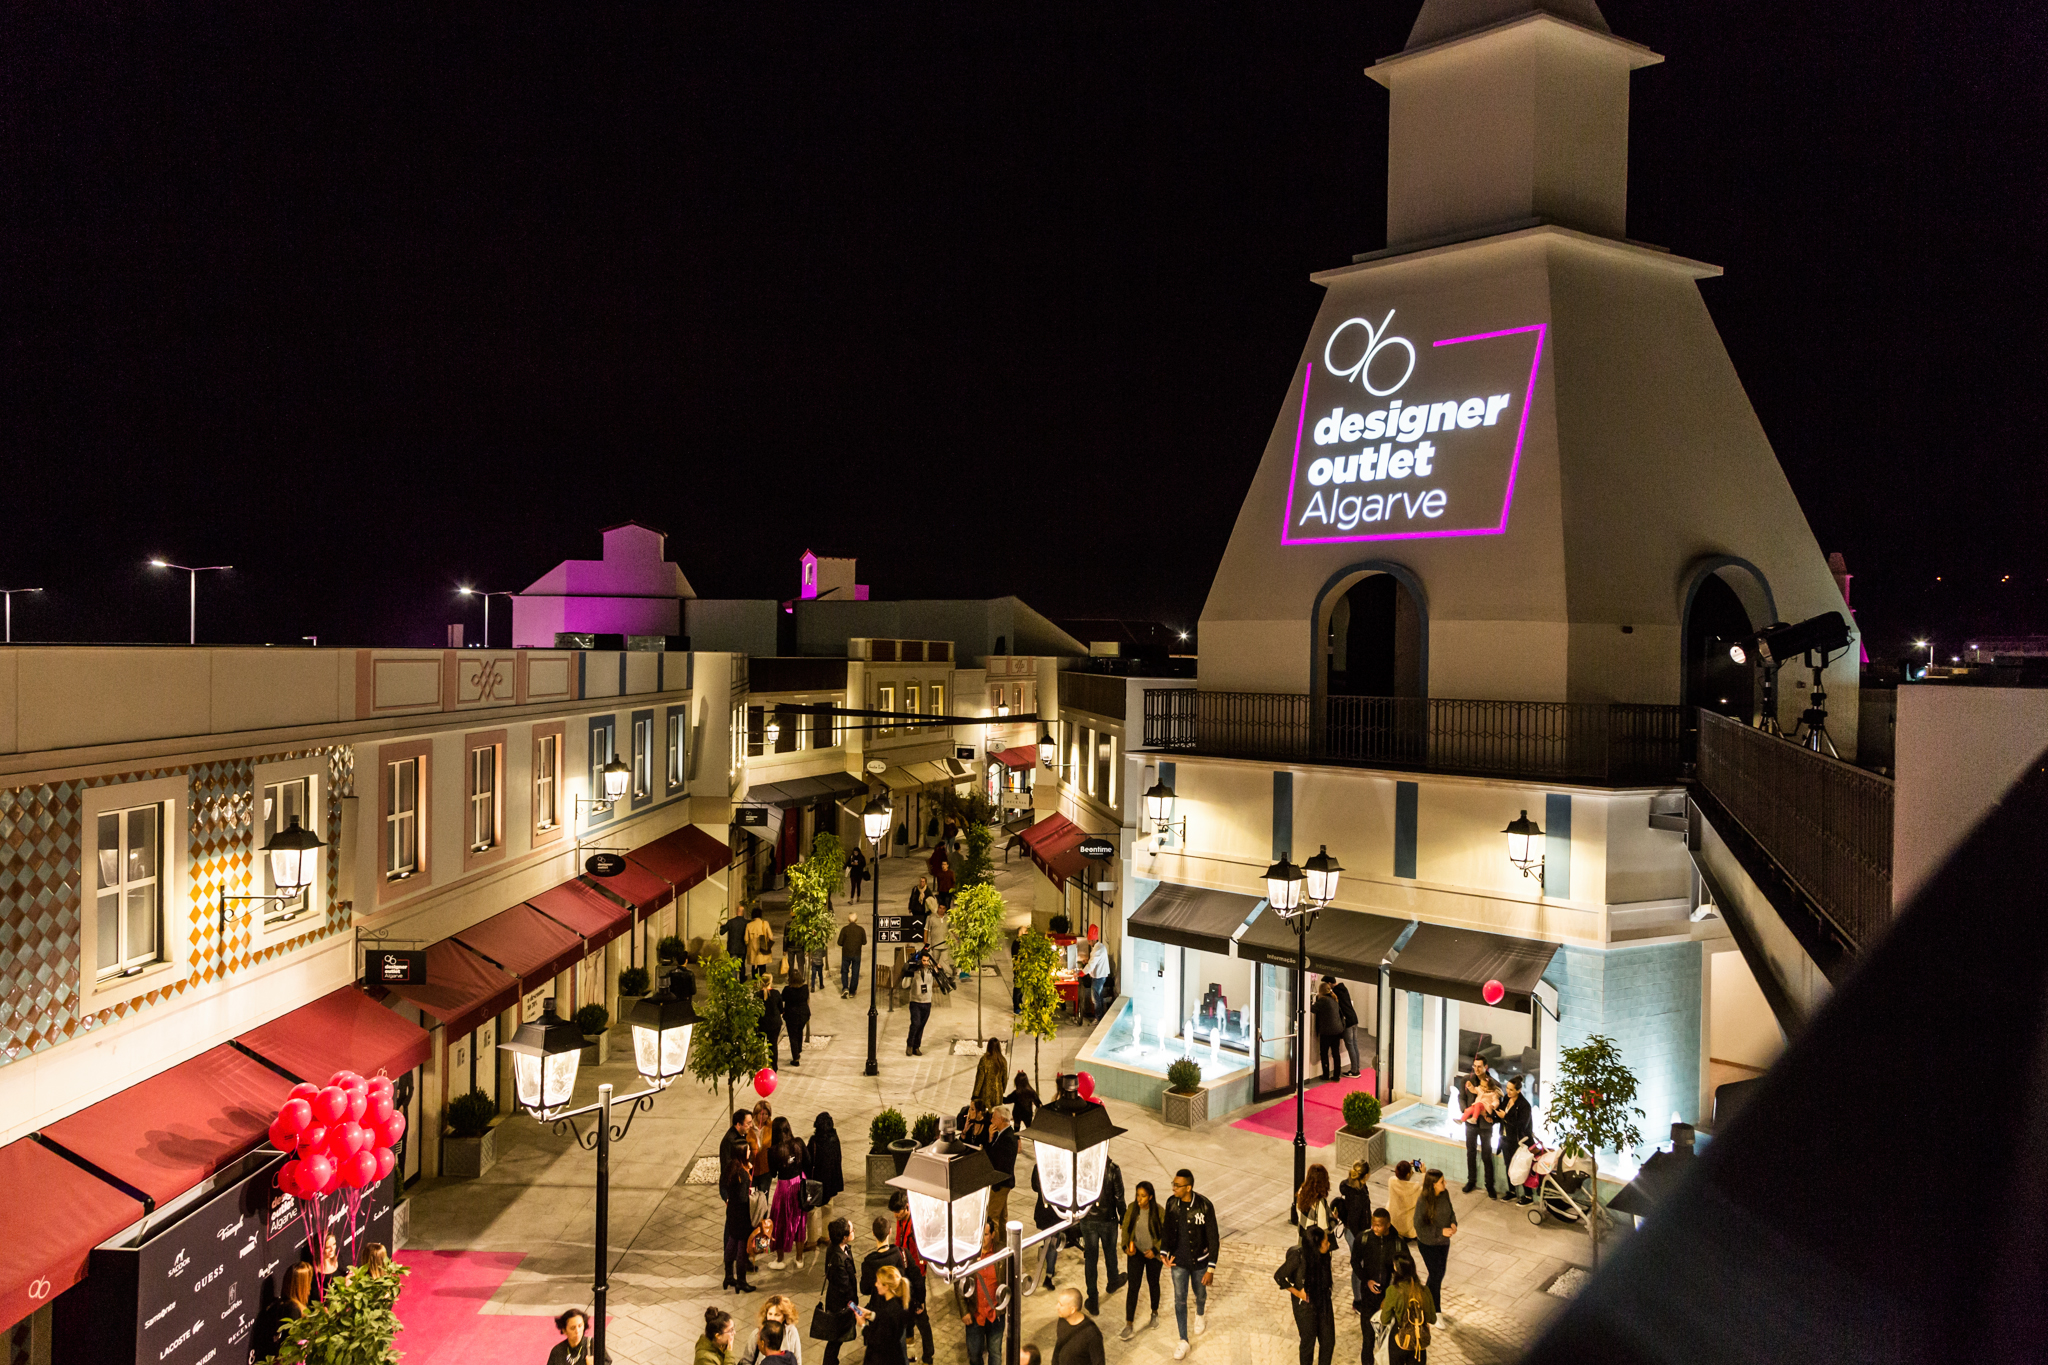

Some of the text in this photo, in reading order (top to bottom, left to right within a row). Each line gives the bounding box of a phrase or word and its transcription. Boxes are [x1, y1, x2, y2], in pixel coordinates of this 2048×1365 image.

[1313, 393, 1511, 444] designer
[1307, 441, 1436, 487] outlet
[1299, 488, 1448, 531] Algarve
[1080, 845, 1112, 853] Beontime
[1266, 953, 1297, 964] Informação
[270, 1207, 298, 1234] Algarve
[194, 1264, 224, 1292] GUESS
[144, 1300, 177, 1330] Samsonite
[159, 1328, 192, 1361] LACOSTE
